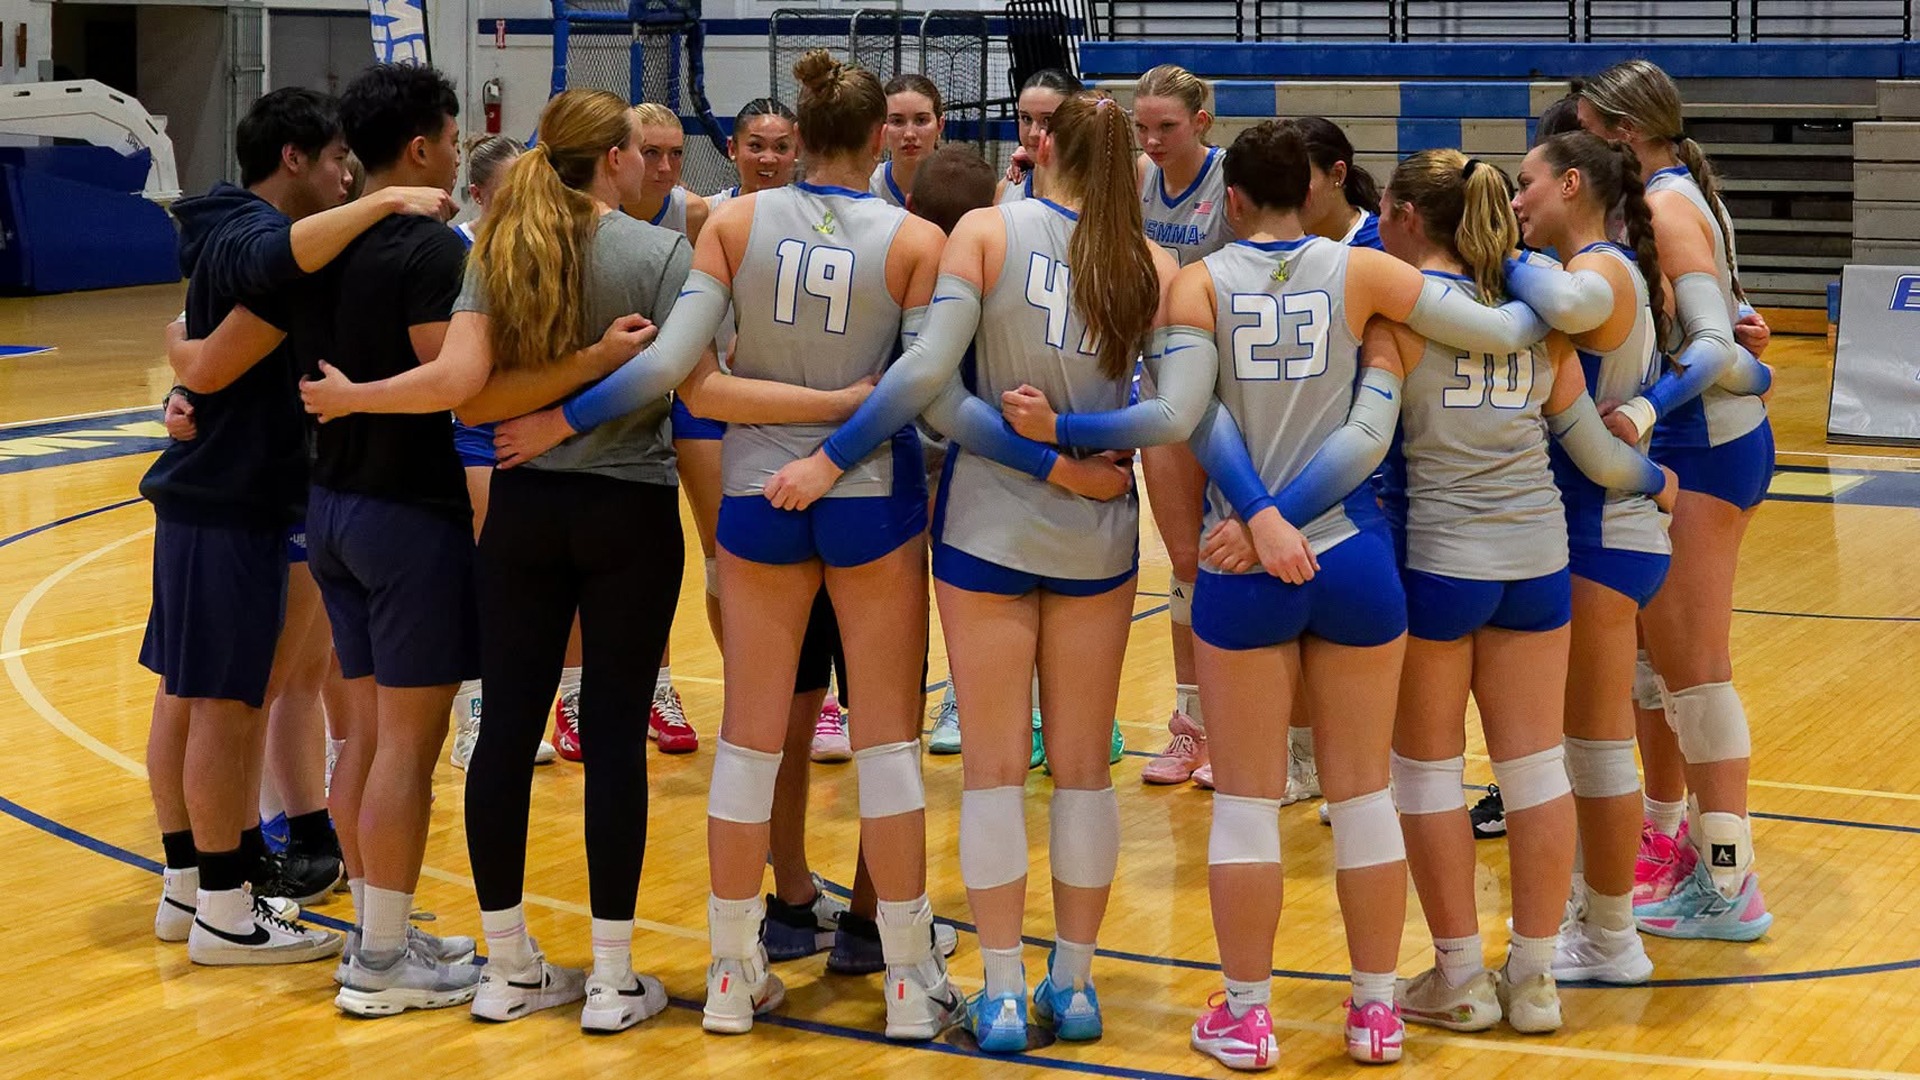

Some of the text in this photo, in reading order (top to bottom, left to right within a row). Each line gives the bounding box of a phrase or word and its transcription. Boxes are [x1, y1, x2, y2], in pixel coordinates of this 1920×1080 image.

[774, 238, 855, 335] 19
[1025, 251, 1101, 356] 4
[1231, 289, 1332, 380] 23
[1443, 346, 1535, 409] 30
